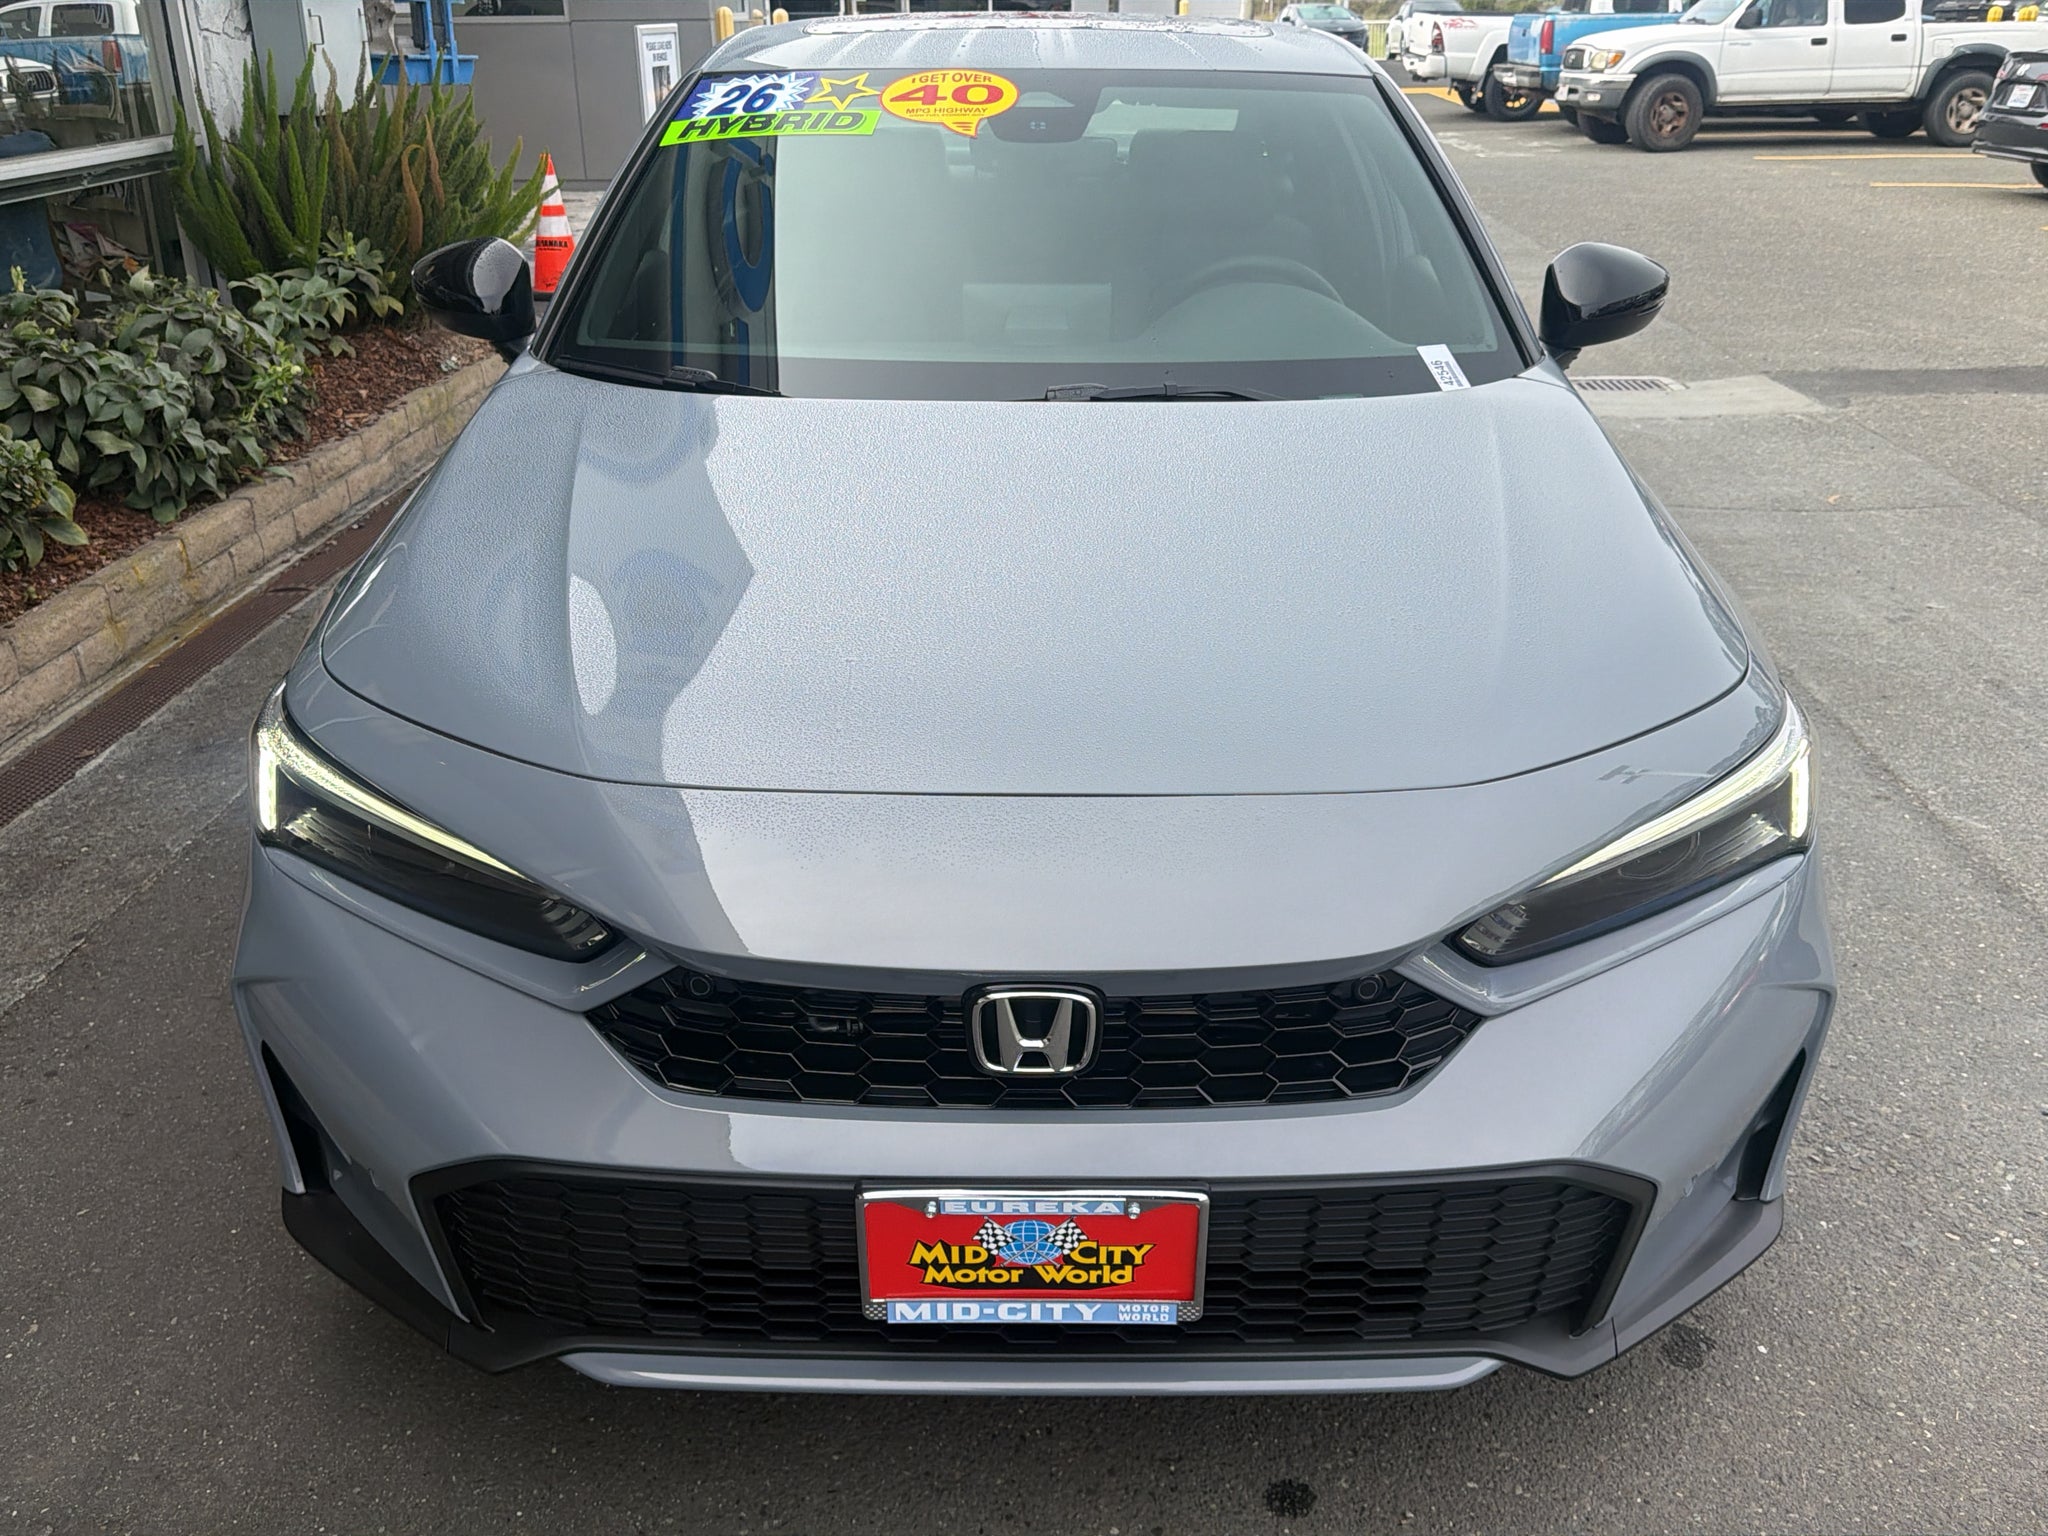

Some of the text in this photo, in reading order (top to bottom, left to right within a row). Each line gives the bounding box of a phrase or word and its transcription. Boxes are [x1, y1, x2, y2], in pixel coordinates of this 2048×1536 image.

[918, 73, 949, 83] GET
[952, 72, 992, 83] OVER
[705, 83, 785, 116] 26
[889, 84, 1004, 106] 40
[677, 111, 867, 141] HYBRID
[944, 1201, 1121, 1214] EUREKA
[909, 1240, 1155, 1265] MID CITY
[923, 1264, 1134, 1284] Motor World
[895, 1302, 1102, 1321] MID-CITY
[1118, 1304, 1170, 1313] MOTOR
[1118, 1313, 1170, 1322] WORLD
